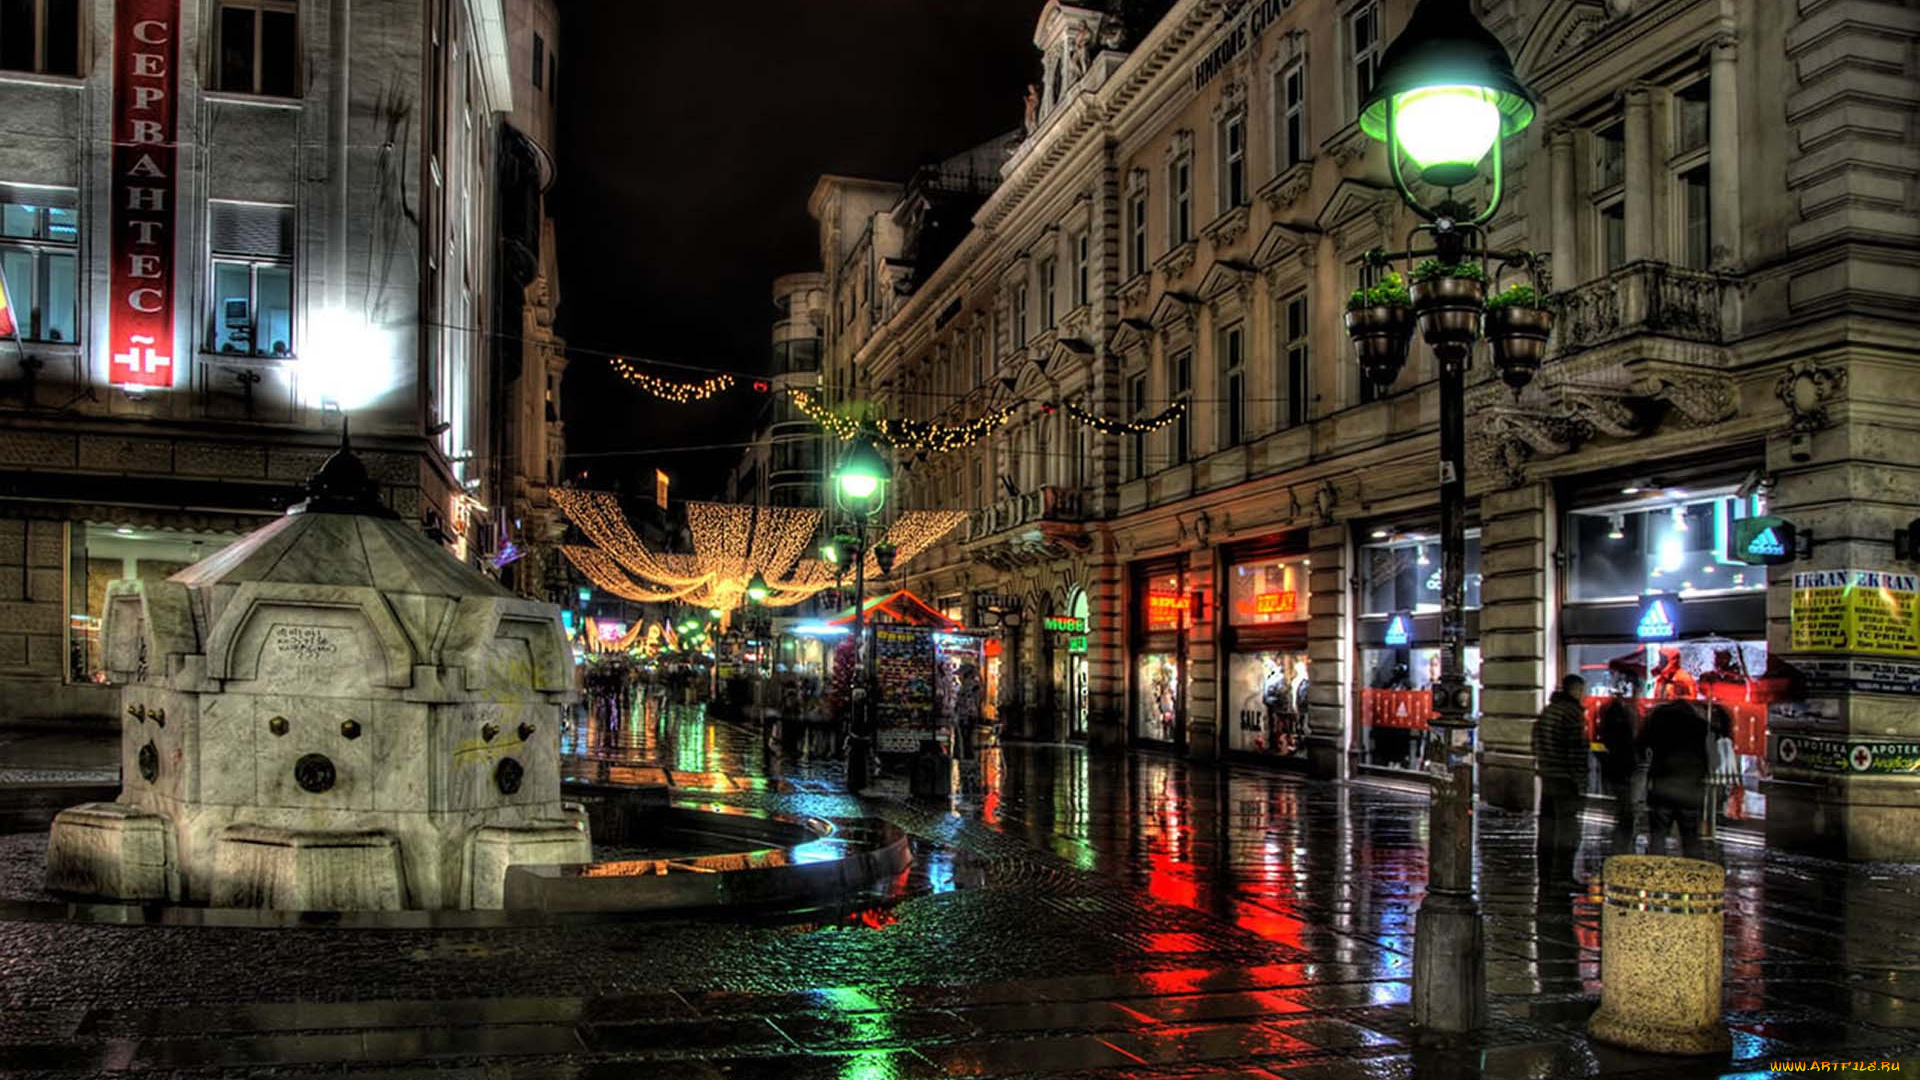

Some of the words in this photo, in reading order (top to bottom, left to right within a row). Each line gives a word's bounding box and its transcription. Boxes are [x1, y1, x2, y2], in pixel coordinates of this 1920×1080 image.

[128, 20, 168, 313] СЕРВАНТЕС
[1794, 570, 1848, 589] EKRAN
[1856, 571, 1915, 591] EKRAN
[1240, 710, 1262, 732] SALE
